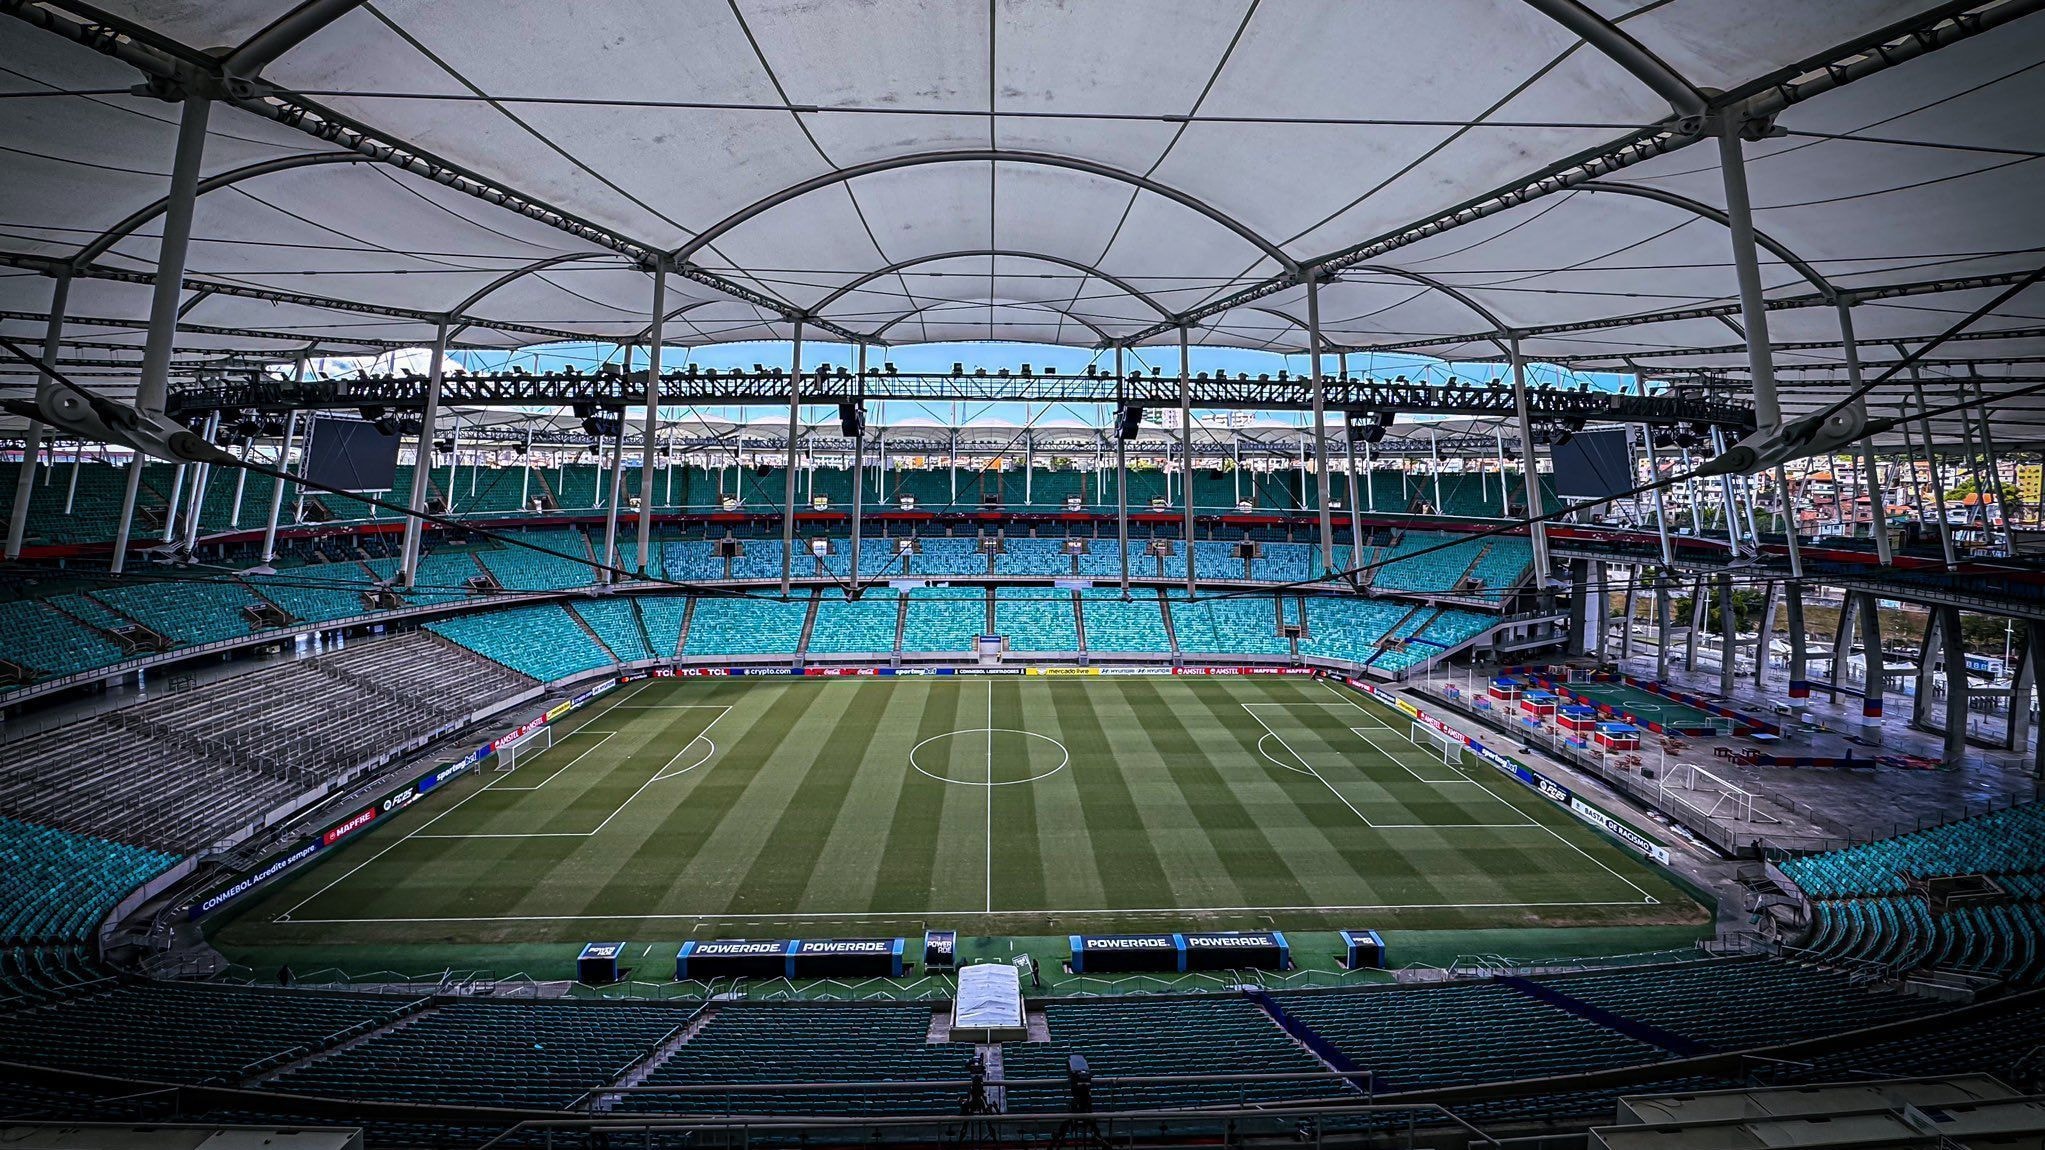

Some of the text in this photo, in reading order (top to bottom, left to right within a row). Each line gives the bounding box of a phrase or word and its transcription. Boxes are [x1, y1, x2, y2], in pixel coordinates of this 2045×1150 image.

[682, 668, 702, 676] TCL
[707, 668, 727, 676] TCL
[750, 668, 791, 676] crypto.com
[500, 730, 519, 745] AMSTEL
[1447, 727, 1466, 743] AMSTEL
[336, 811, 371, 836] MAPFRE
[1584, 807, 1649, 851] BASTA DE RACISMO
[202, 844, 315, 911] CONMEBOL Acredite sempre
[927, 940, 952, 948] POWER
[1087, 939, 1170, 948] POWERADE
[1189, 937, 1272, 946] POWERADE
[695, 943, 780, 954] POWERADE
[802, 942, 887, 952] POWERADE
